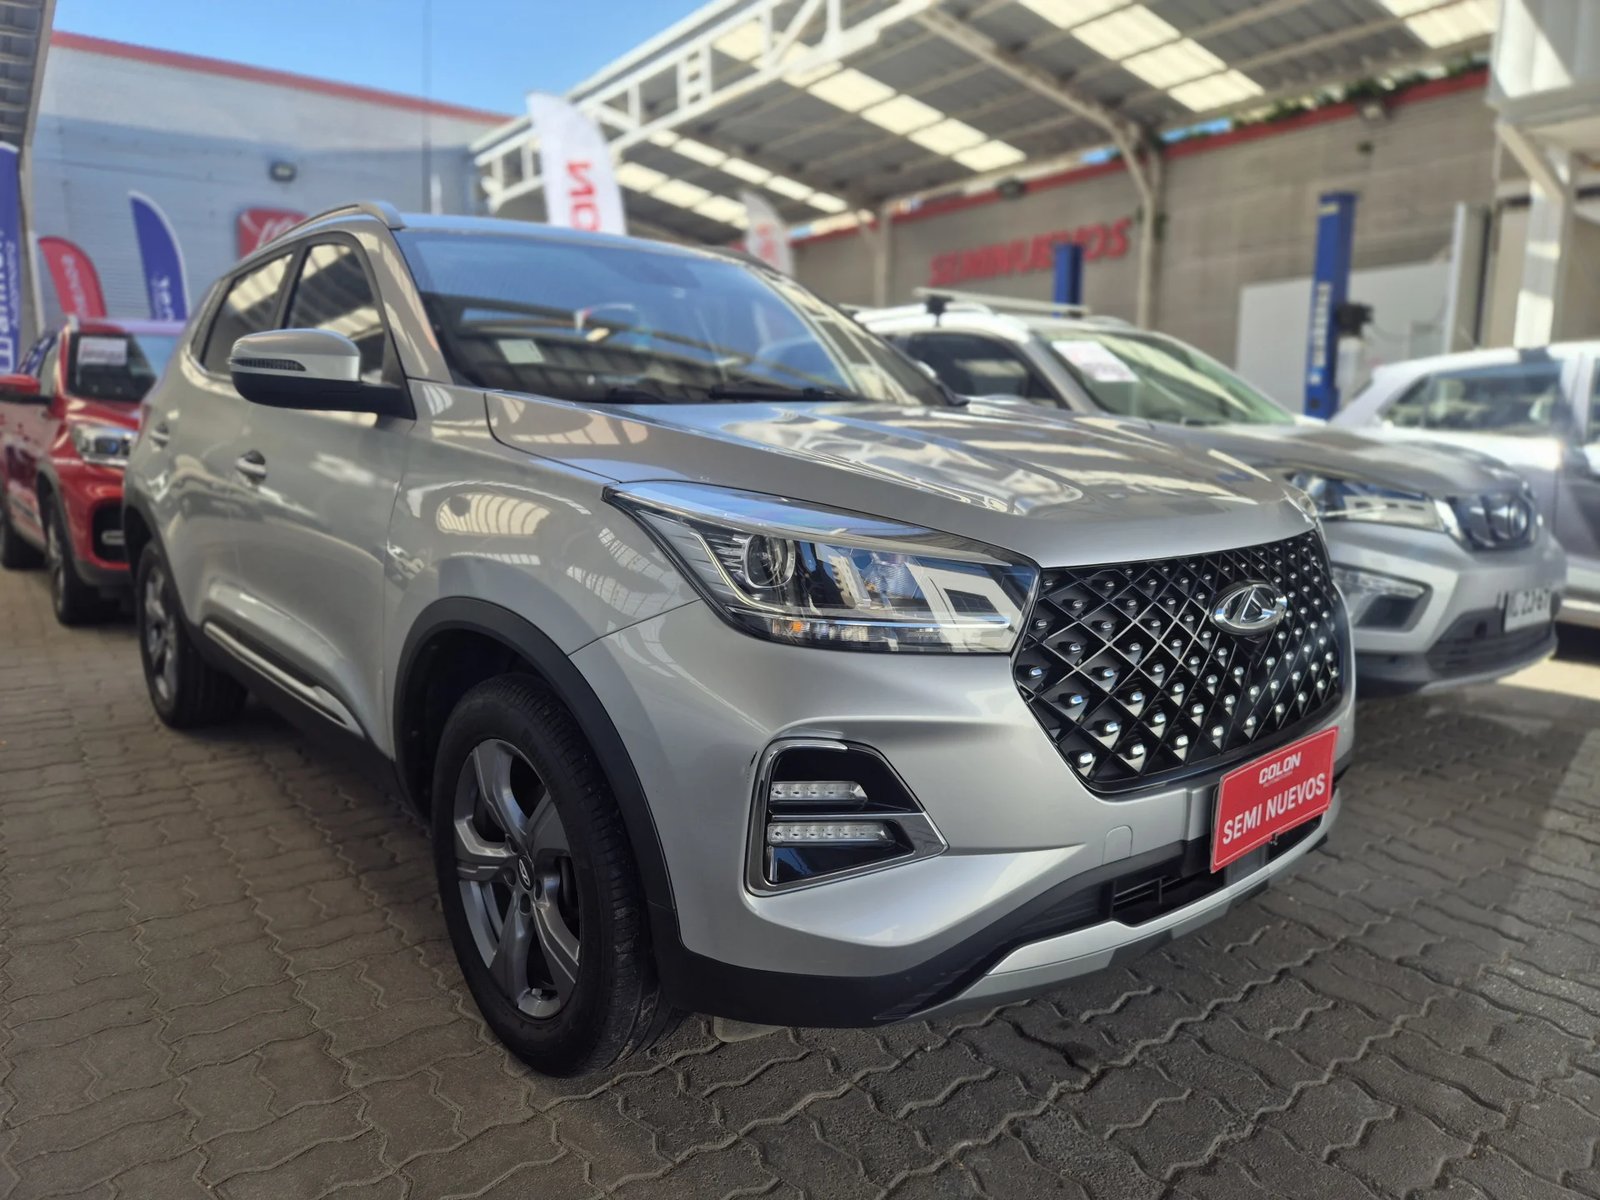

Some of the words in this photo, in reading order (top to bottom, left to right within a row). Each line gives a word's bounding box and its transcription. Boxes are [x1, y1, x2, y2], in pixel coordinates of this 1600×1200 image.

[1258, 751, 1302, 785] COLON
[1222, 803, 1263, 845] SEMI
[1265, 772, 1326, 821] NUEVOS
